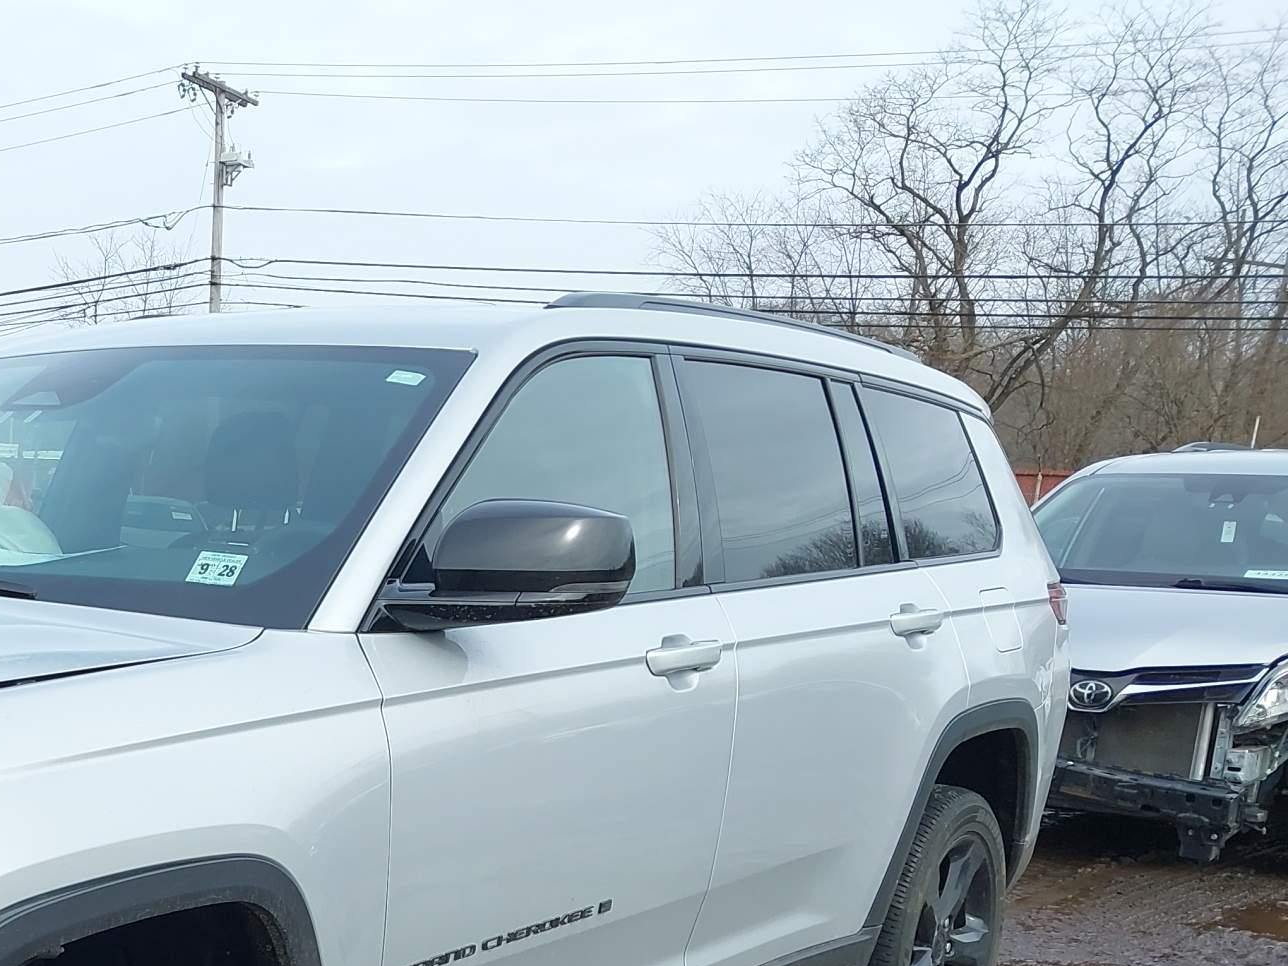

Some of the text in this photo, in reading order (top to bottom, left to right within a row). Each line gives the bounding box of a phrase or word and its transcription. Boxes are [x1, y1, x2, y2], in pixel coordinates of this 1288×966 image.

[198, 563, 238, 577] 9 28
[481, 905, 594, 951] CHEROKEE
